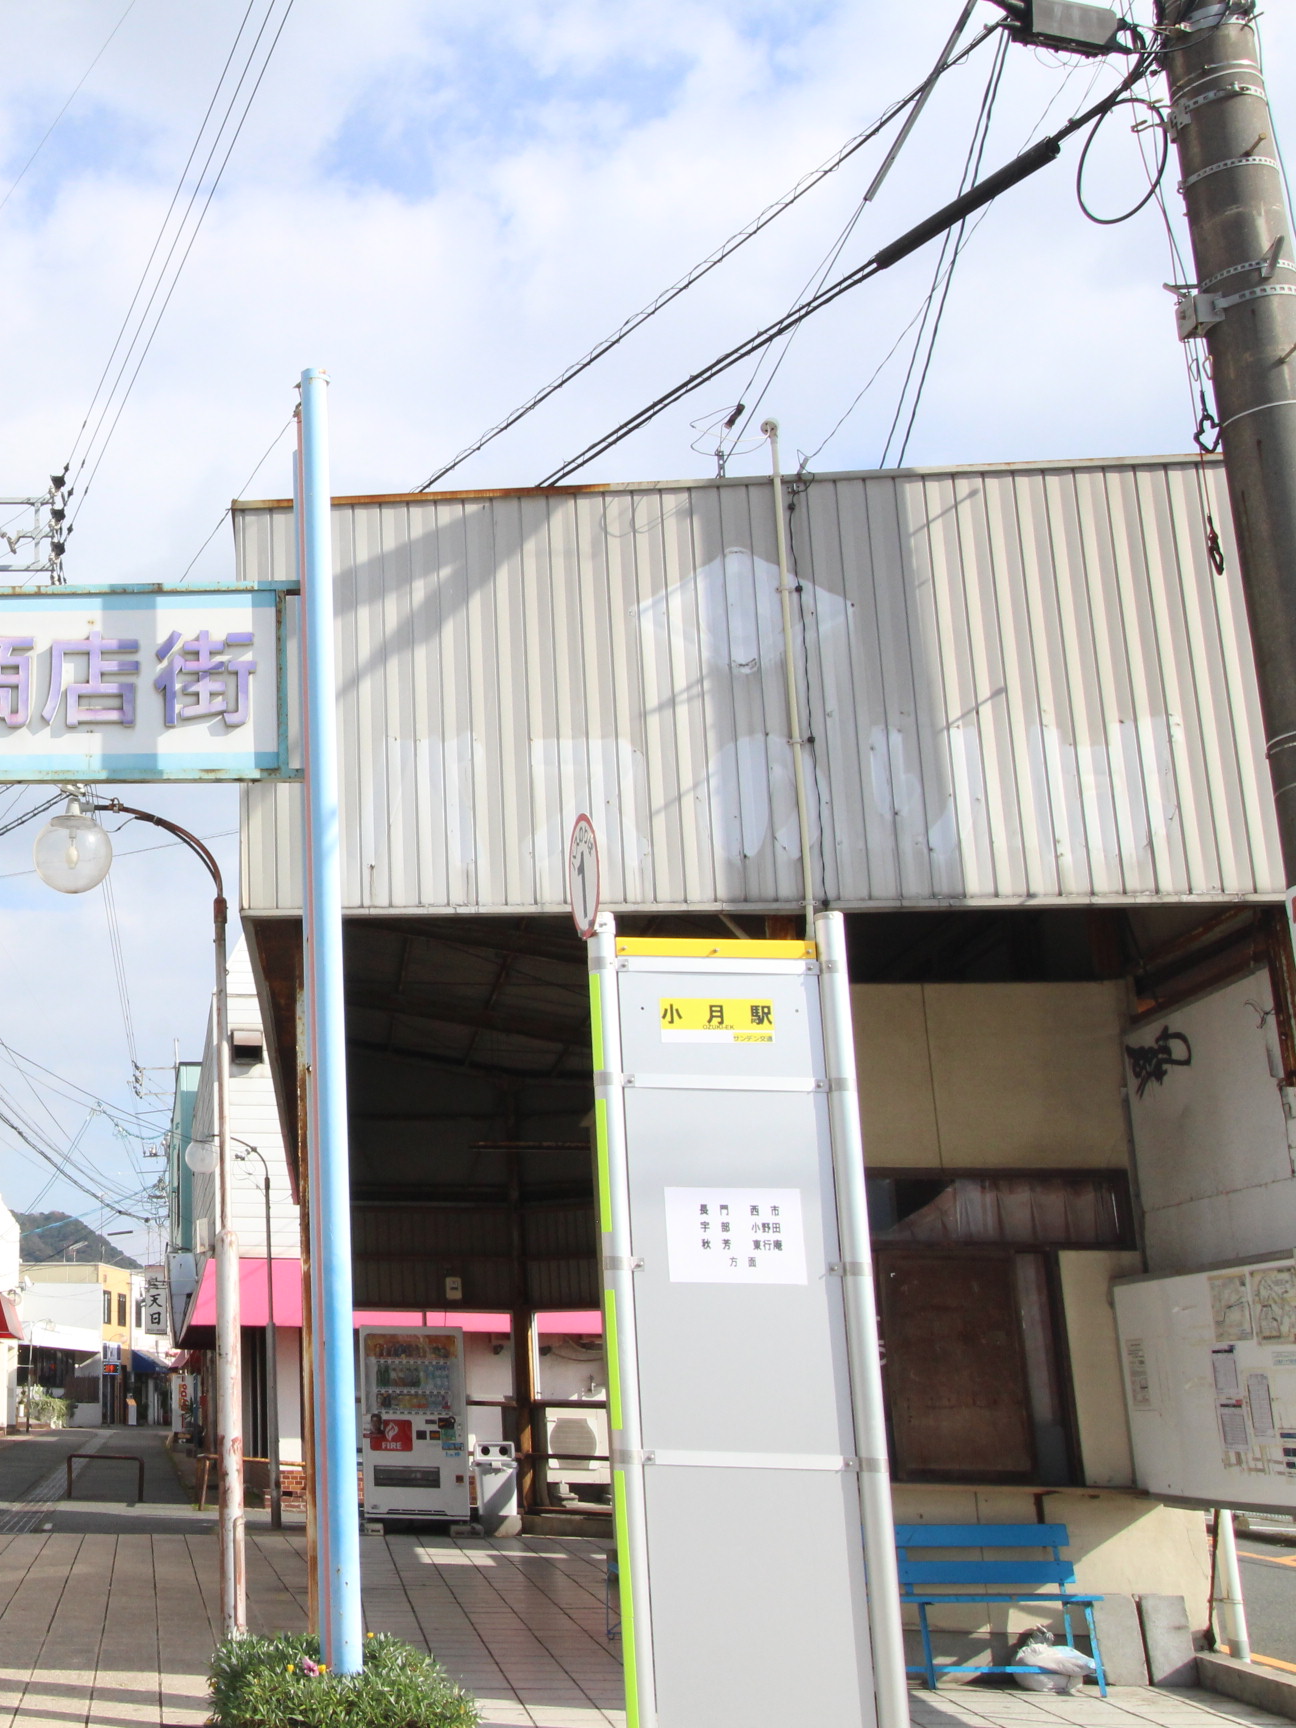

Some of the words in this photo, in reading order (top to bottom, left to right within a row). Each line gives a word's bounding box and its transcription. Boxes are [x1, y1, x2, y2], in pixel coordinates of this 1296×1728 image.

[577, 850, 588, 920] 1
[661, 1003, 773, 1025] 小月駅
[699, 1204, 730, 1216] 長門
[749, 1204, 780, 1217] 西市
[700, 1221, 730, 1233] 宇部
[751, 1221, 781, 1234] 小野田
[701, 1238, 732, 1250] 秋芳
[752, 1239, 783, 1252] 東行庵
[729, 1256, 757, 1268] 方面
[381, 1441, 403, 1450] FIRE
